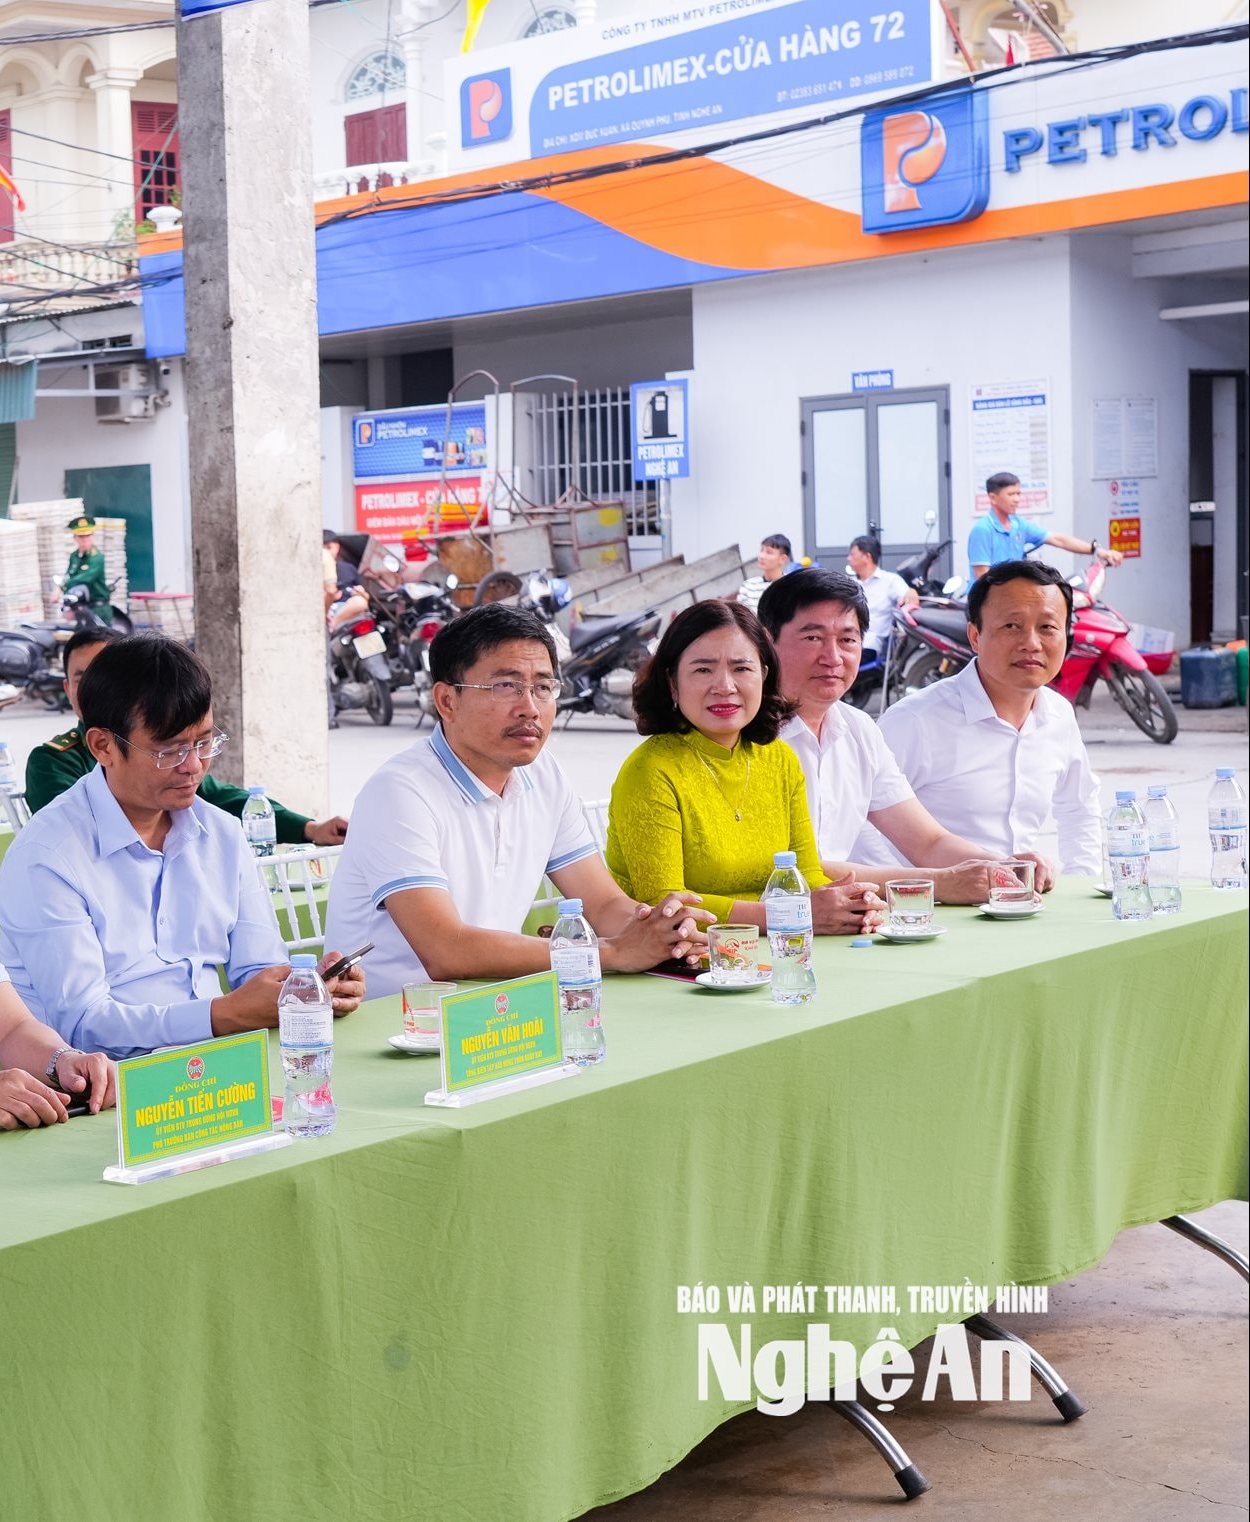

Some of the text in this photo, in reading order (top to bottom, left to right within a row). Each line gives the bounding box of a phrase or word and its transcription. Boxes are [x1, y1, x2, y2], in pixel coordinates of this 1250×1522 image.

[634, 21, 647, 32] TY
[650, 13, 680, 30] TNHH
[683, 8, 705, 22] MTV
[779, 20, 862, 64] HÀNG
[870, 10, 906, 44] 72
[637, 443, 685, 460] PETROLIMEX
[667, 459, 679, 475] AN
[361, 491, 420, 511] PETROLIMEX
[461, 1024, 500, 1056] NGUYỄN
[501, 1023, 520, 1046] VĂN
[175, 1080, 200, 1093] ĐỒNG
[135, 1081, 256, 1128] NGUYỄN TIẾN CƯỜNG
[186, 1116, 202, 1128] TRUNG
